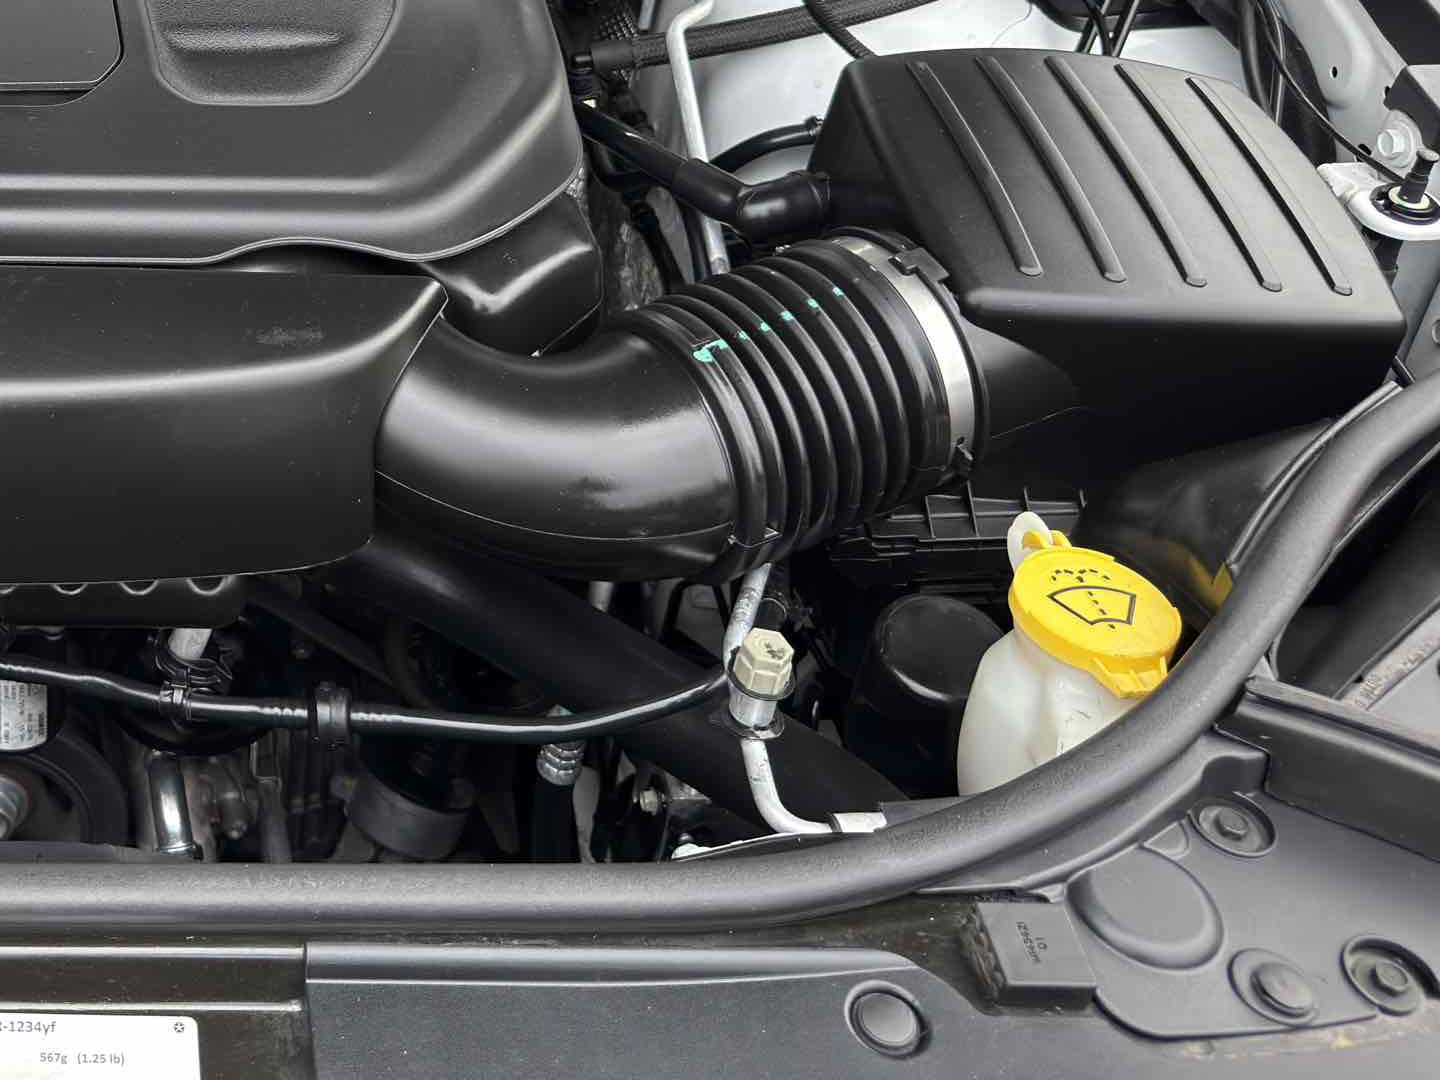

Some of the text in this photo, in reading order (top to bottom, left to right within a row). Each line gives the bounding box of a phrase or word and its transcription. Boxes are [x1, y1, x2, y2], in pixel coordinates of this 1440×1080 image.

[40, 1052, 125, 1066] 567g (1.25 lb)
